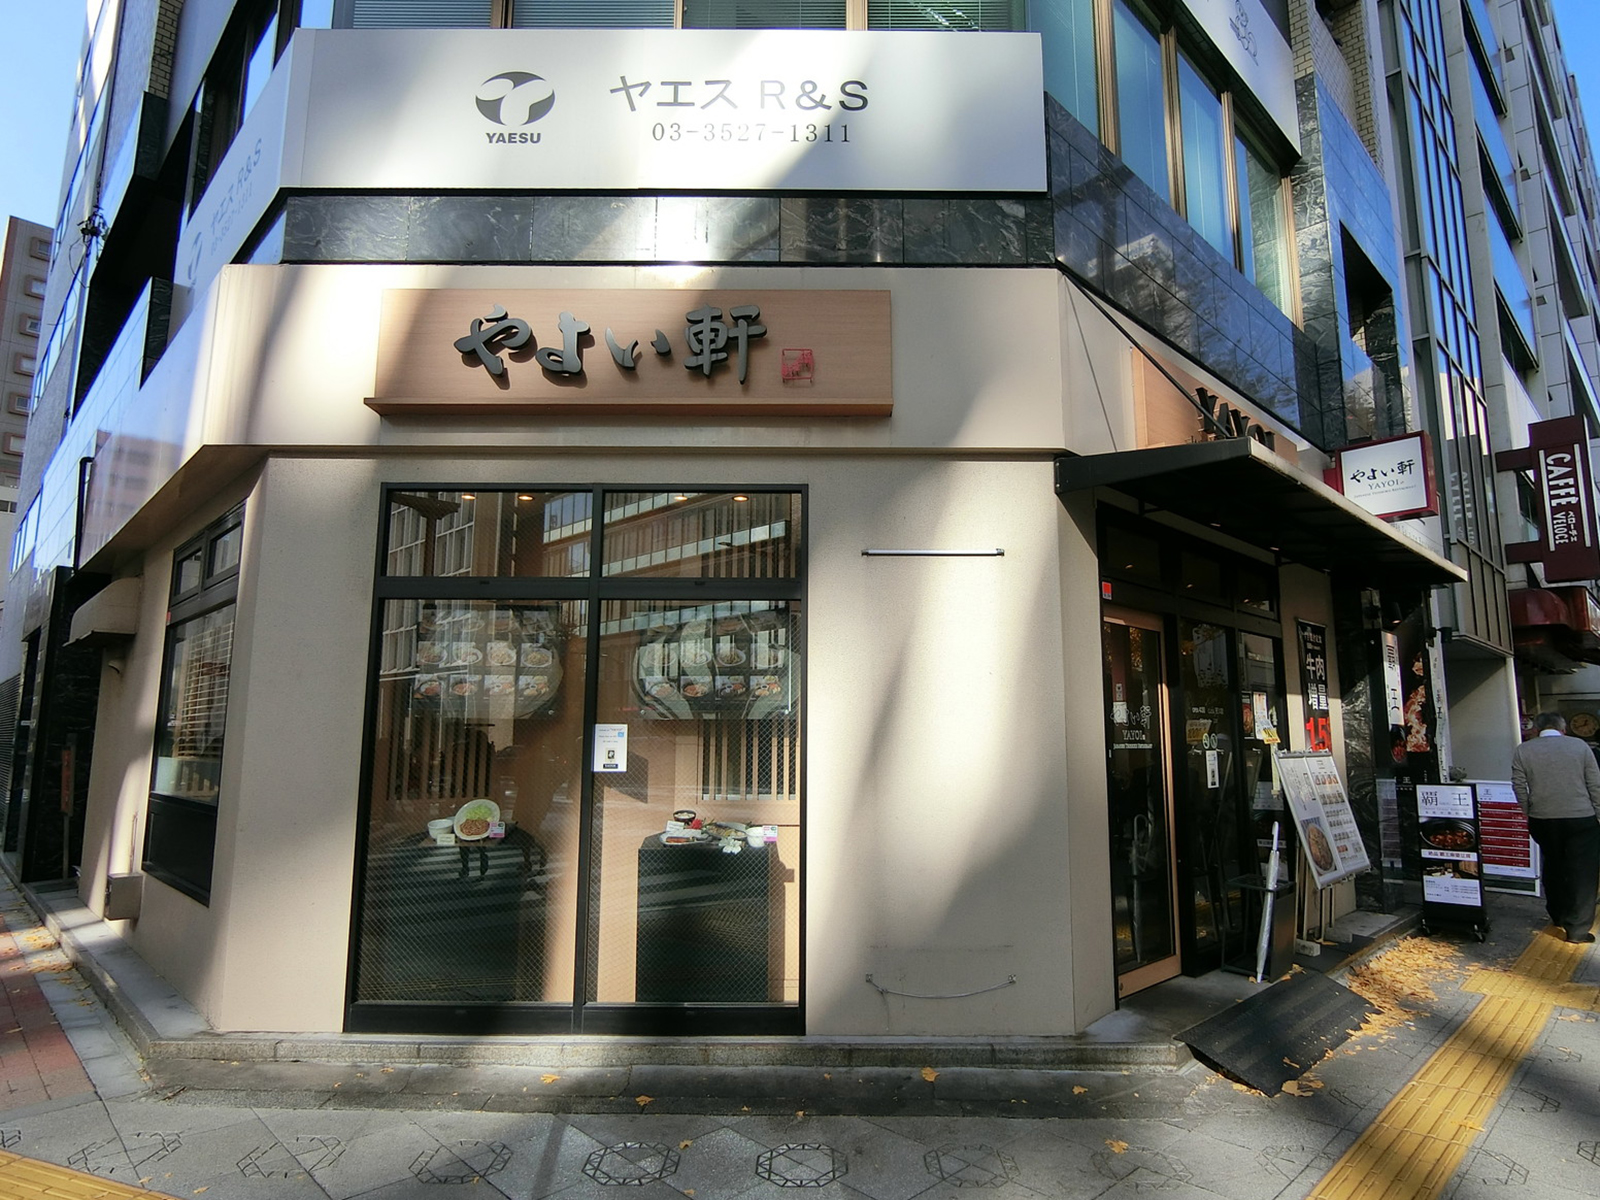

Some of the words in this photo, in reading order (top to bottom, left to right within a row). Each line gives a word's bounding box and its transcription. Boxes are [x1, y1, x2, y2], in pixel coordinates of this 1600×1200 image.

[610, 75, 738, 112] ヤエス
[760, 79, 869, 112] R&S
[486, 132, 541, 144] YAESU
[651, 122, 850, 143] 03-3527-1311
[453, 303, 767, 385] やよい軒
[1350, 459, 1415, 484] やよい軒
[1368, 478, 1399, 490] YAYOI
[1553, 511, 1569, 545] VELOCE
[1306, 653, 1326, 680] 牛肉
[1307, 683, 1329, 710] 増量
